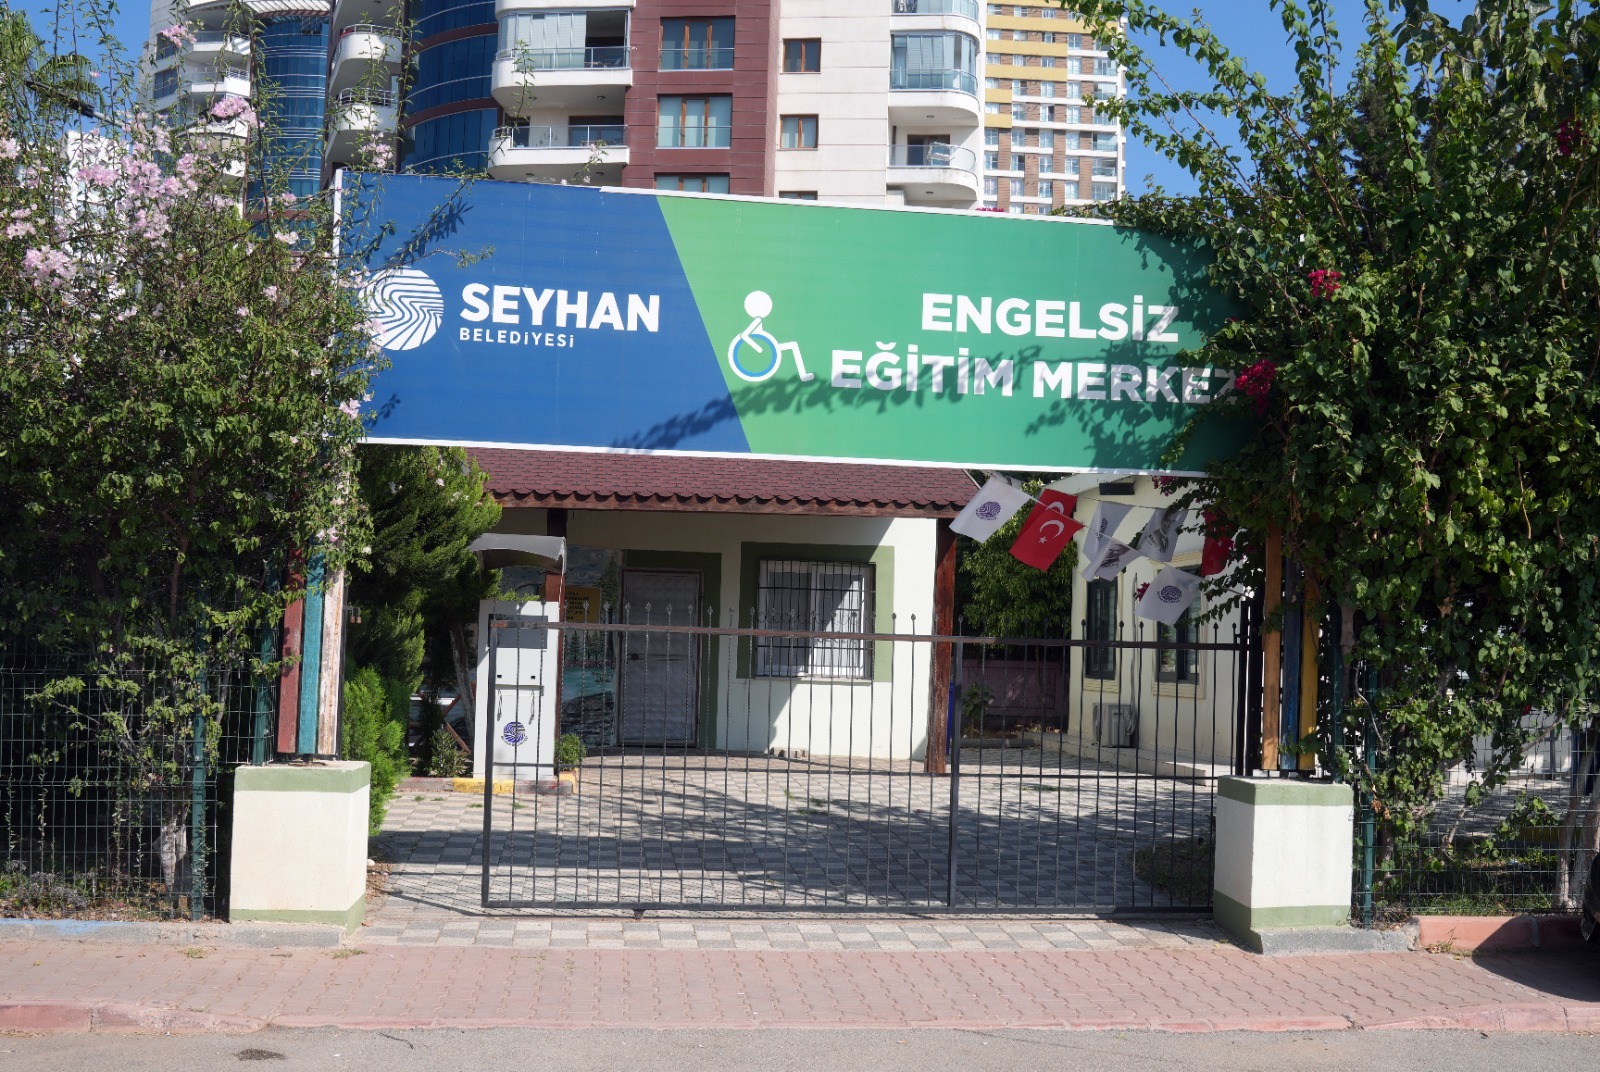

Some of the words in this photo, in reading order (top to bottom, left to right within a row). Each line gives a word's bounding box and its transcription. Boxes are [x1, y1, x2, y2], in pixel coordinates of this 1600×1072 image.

[459, 282, 661, 333] SEYHAN
[920, 292, 1180, 345] ENGELSİZ
[829, 341, 1015, 398] EĞİTİM
[1032, 360, 1238, 407] MERKEZ
